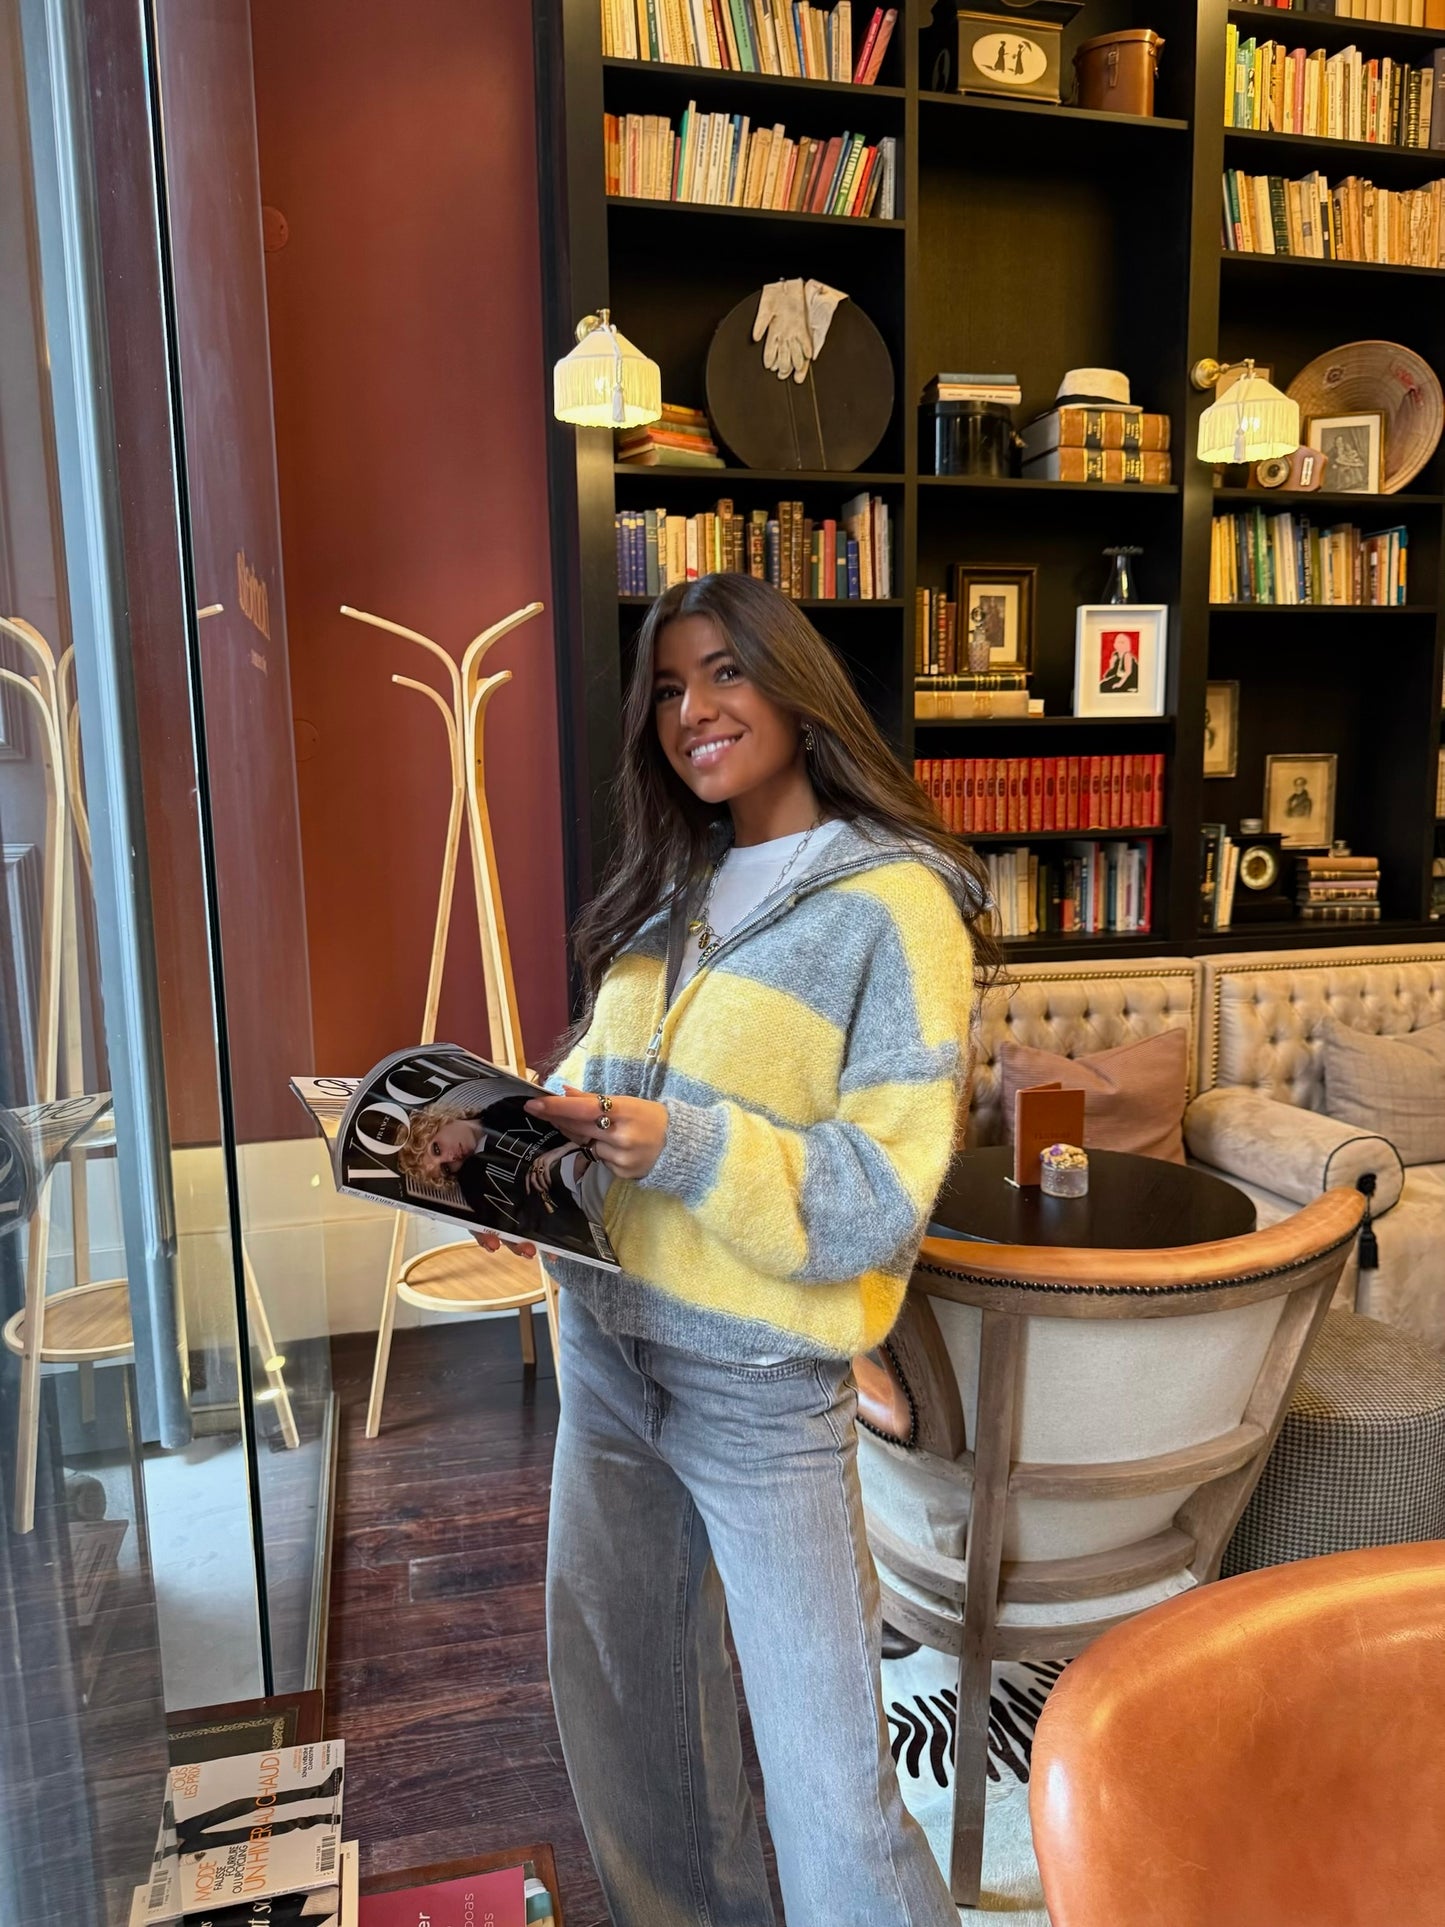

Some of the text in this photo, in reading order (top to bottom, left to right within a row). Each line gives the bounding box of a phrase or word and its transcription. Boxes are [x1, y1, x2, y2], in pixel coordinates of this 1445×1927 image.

[346, 1055, 500, 1184] VOGU
[483, 1116, 544, 1225] MILEY
[184, 1764, 201, 1800] LES PRIX
[252, 1807, 275, 1823] AU
[225, 1845, 239, 1877] FOURRURE
[246, 1824, 273, 1864] HIVER
[193, 1861, 217, 1902] MODE
[213, 1866, 227, 1892] FAUSSE
[243, 1864, 268, 1893] UN
